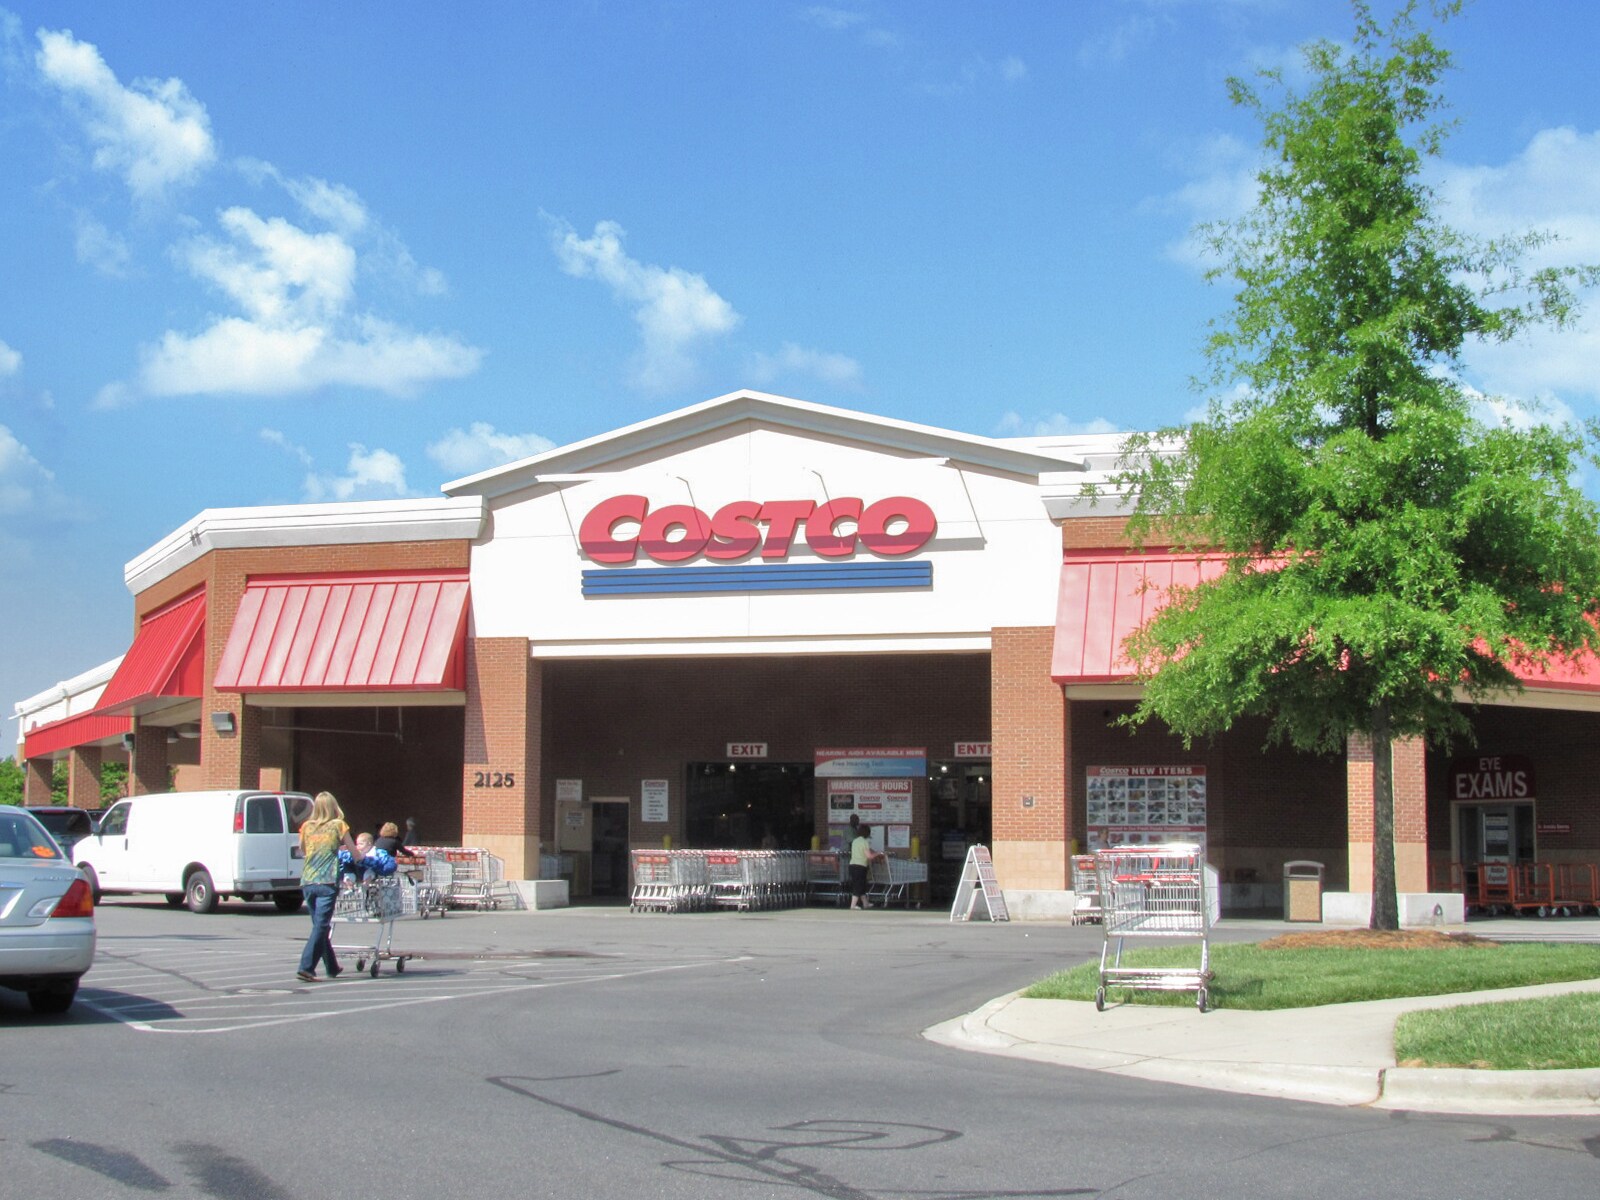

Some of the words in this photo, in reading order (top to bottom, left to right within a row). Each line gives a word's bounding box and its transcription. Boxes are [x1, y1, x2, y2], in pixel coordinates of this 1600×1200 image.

[579, 495, 937, 563] COSTCO
[731, 745, 764, 756] EXIT
[1479, 757, 1501, 770] EYE
[1131, 767, 1155, 775] NEW
[1159, 767, 1193, 775] ITEMS
[474, 772, 515, 788] 2125
[831, 781, 880, 790] WAREHOUSE
[881, 781, 909, 791] HOURS
[1456, 771, 1528, 798] EXAMS
